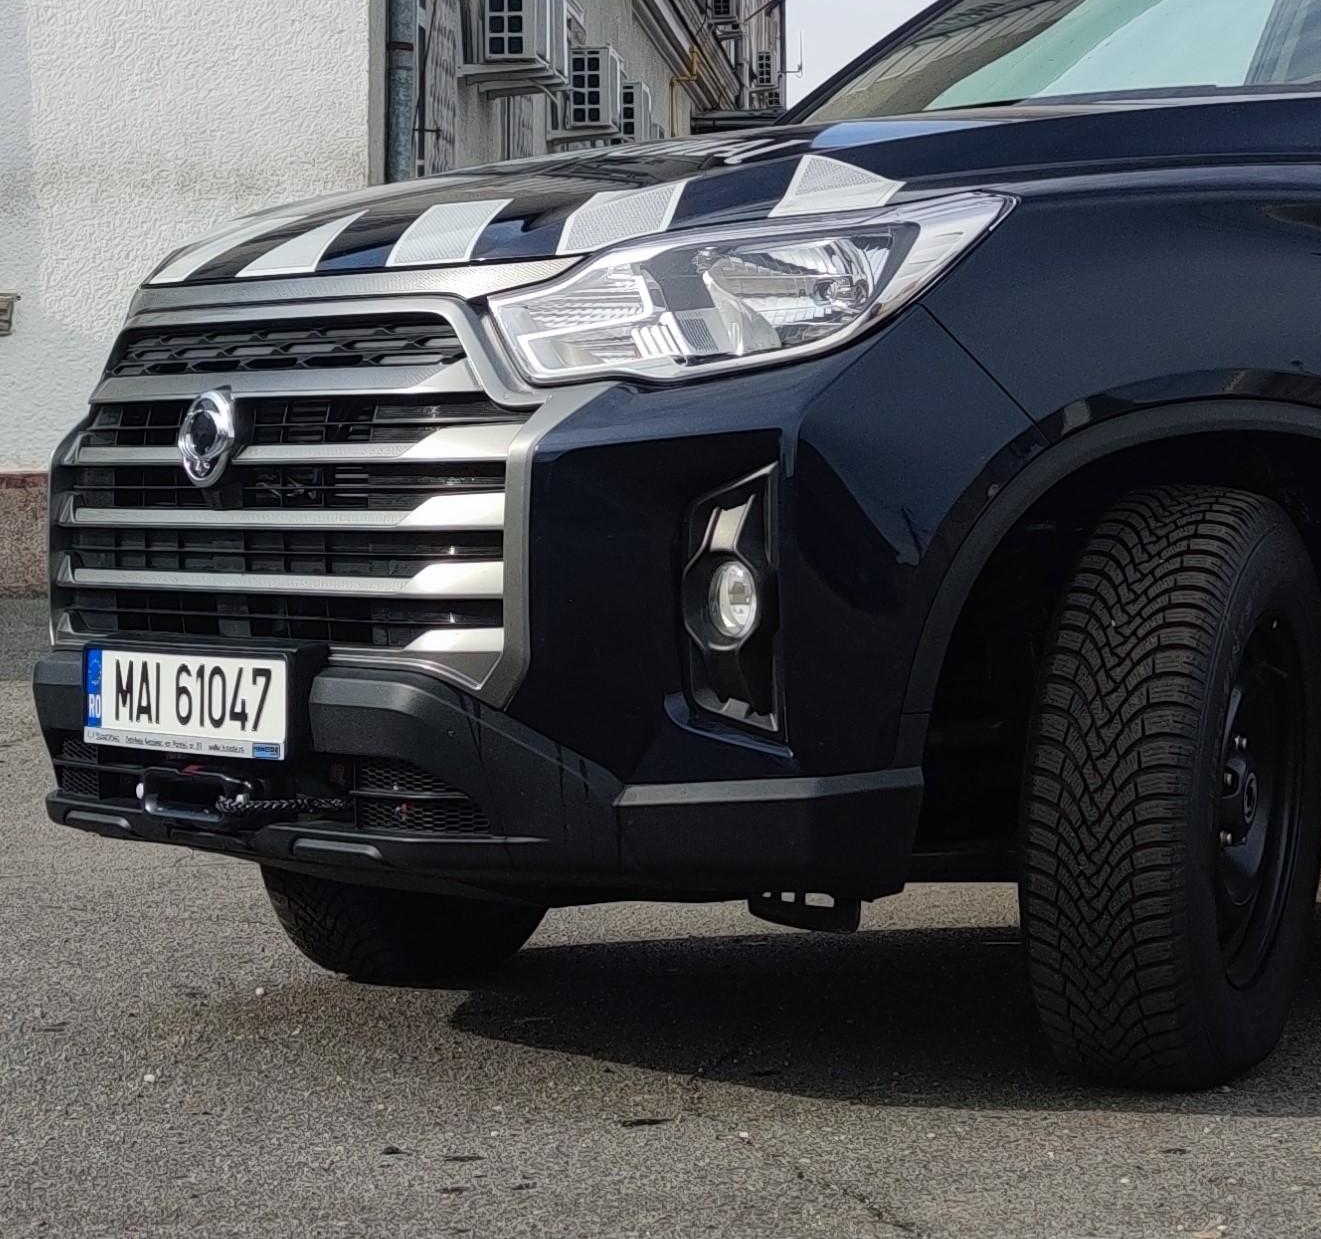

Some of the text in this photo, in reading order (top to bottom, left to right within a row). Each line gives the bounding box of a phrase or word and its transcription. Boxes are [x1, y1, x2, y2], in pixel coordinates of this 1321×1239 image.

[88, 693, 101, 718] RO
[115, 658, 273, 732] MAI 61047
